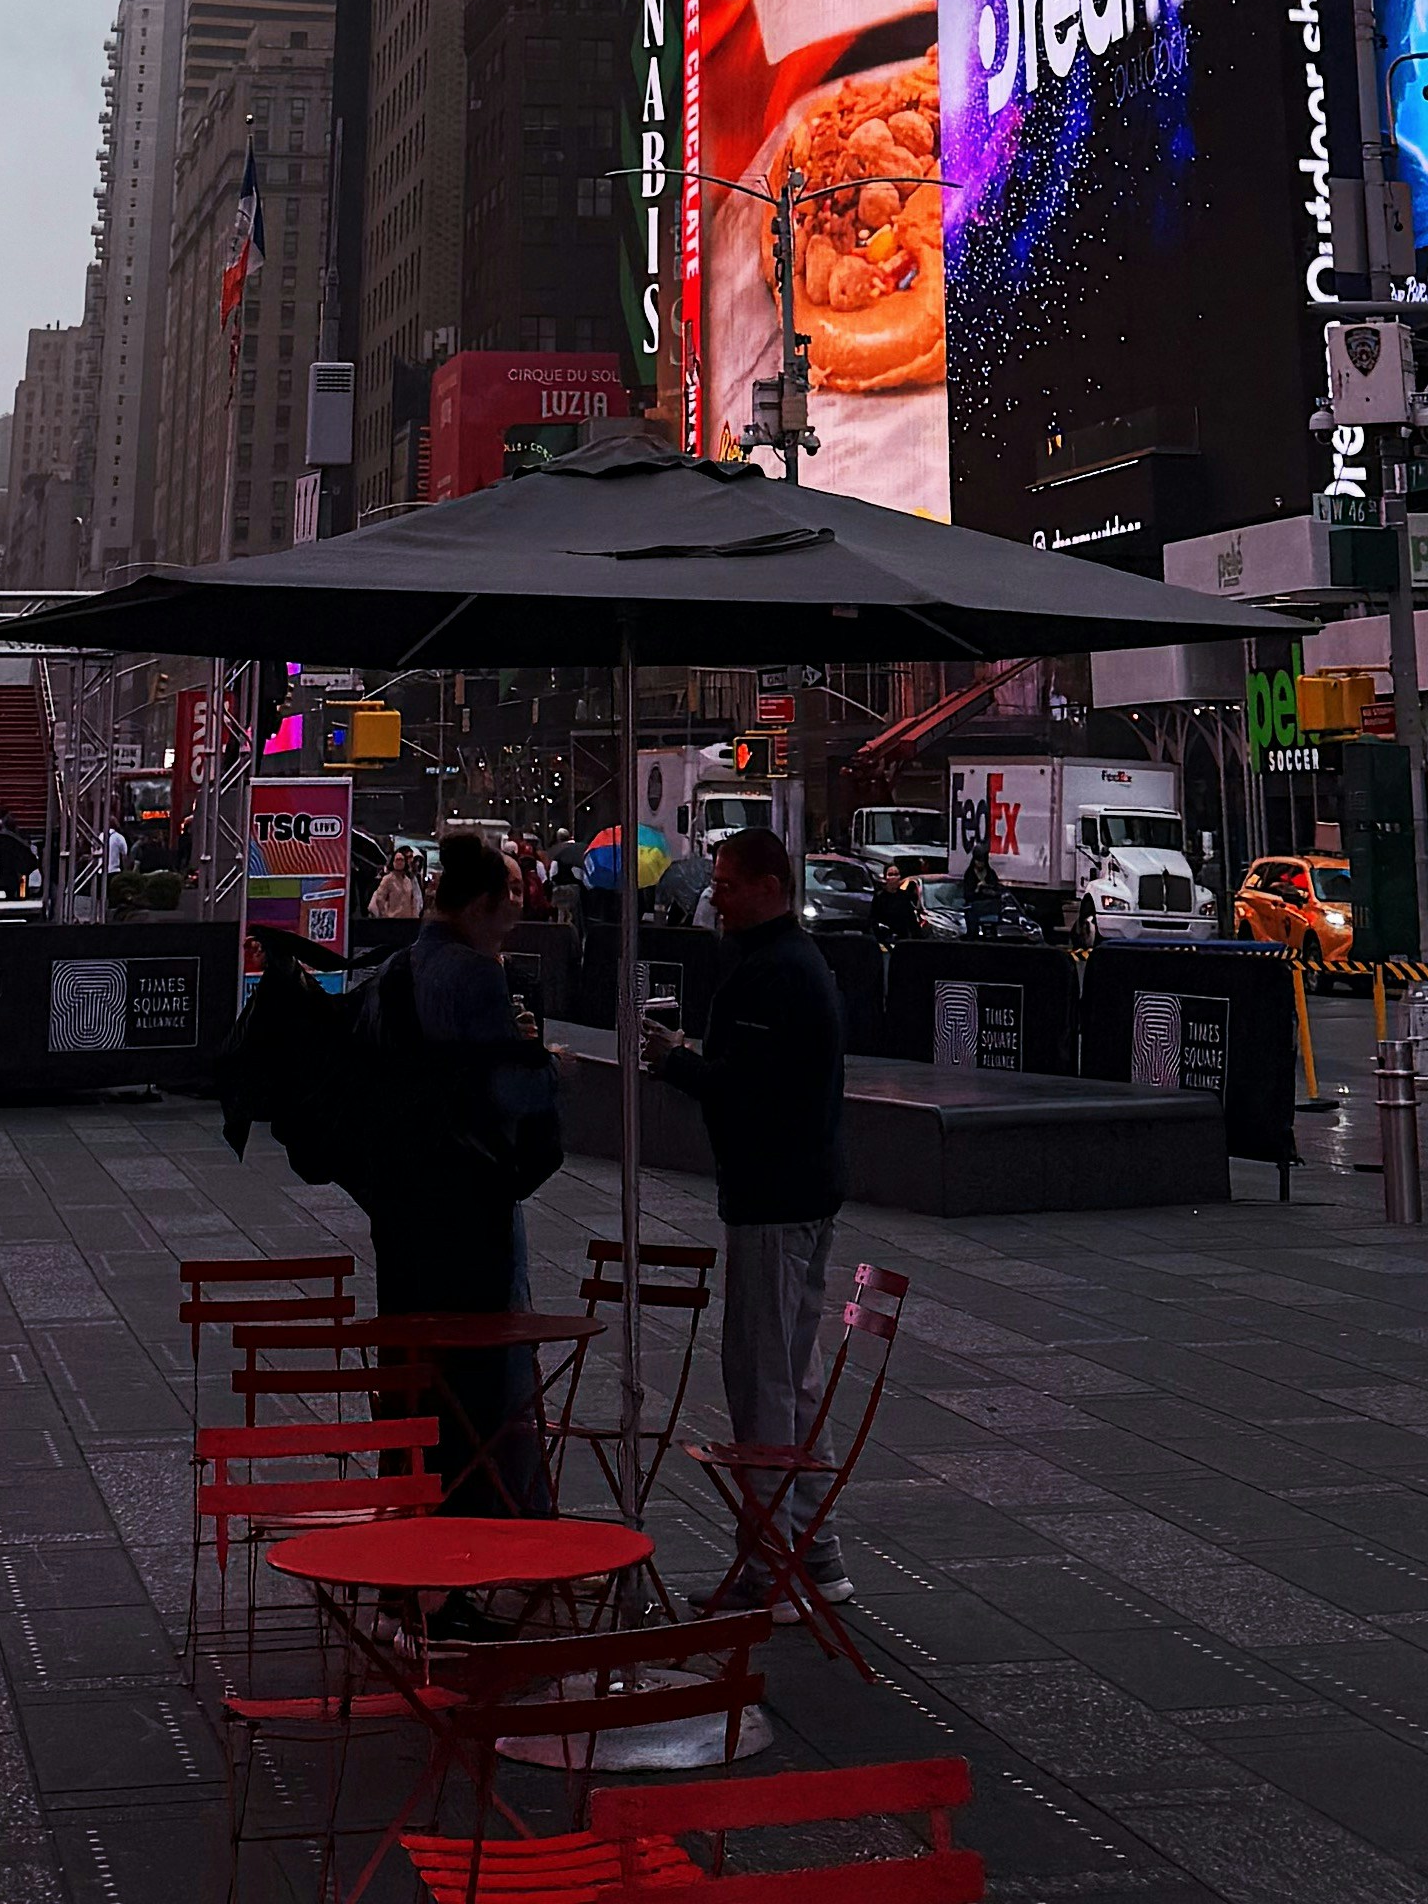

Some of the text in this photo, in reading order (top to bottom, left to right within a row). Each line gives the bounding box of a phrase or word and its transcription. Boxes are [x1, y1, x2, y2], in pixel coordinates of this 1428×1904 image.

[685, 47, 700, 281] CHOCOLATE
[508, 368, 587, 385] CIRQUE DU
[542, 390, 608, 419] LUZIA
[1332, 500, 1365, 523] W 46
[1269, 748, 1320, 772] SOCCER
[1102, 769, 1133, 784] FedEx
[951, 772, 1021, 856] FedEx
[254, 813, 336, 845] TSQ LIVE
[137, 977, 186, 995] TIMES
[132, 994, 191, 1014] SQUARE
